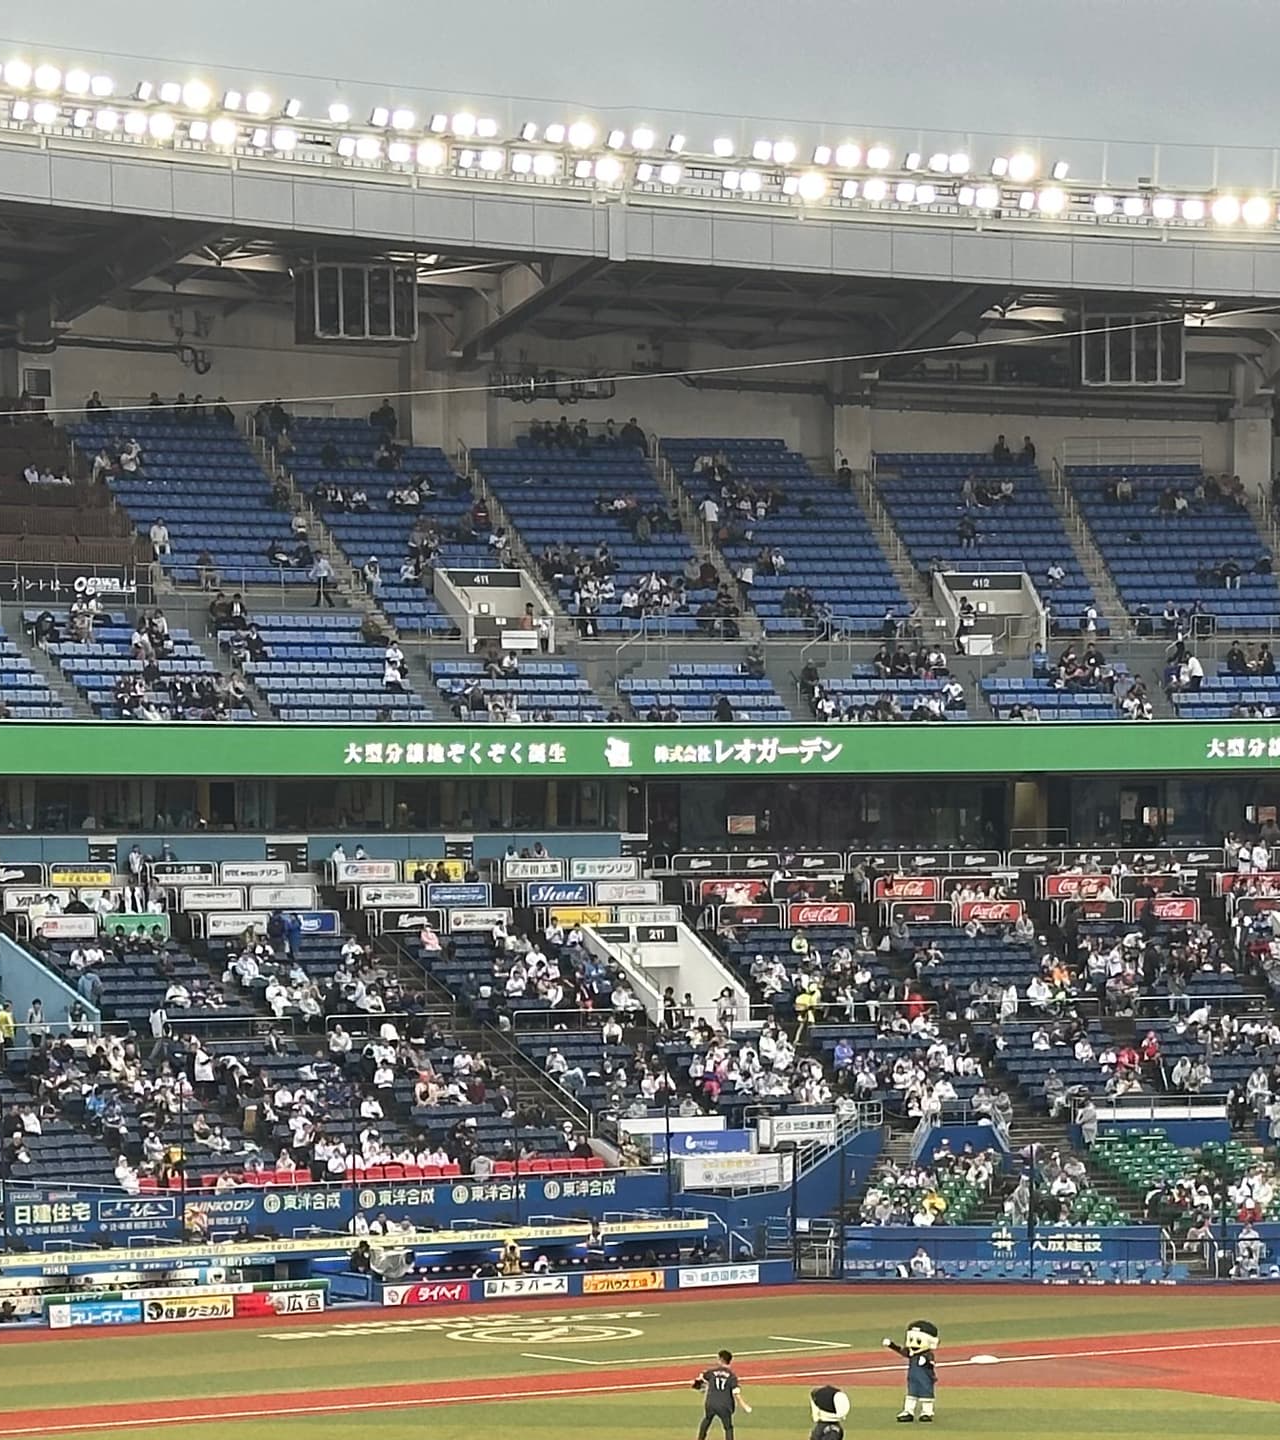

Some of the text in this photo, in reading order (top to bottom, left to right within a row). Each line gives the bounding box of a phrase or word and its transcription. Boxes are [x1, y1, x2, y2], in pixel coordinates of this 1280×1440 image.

[473, 575, 489, 585] 411
[971, 578, 990, 588] 412
[654, 738, 842, 764] 株式会社レオガーデン
[648, 930, 666, 941] 211
[378, 1187, 435, 1205] 東洋合成
[471, 1183, 527, 1201] 東洋合成
[563, 1179, 616, 1196] 東洋合成
[283, 1192, 341, 1210] 東洋合成
[13, 1203, 92, 1225] 日建住宅
[417, 1286, 463, 1302] タイヘイ
[498, 1278, 566, 1294] トラバース
[286, 1292, 322, 1311] 広宣
[164, 1303, 231, 1319] 佐藤ケミカル
